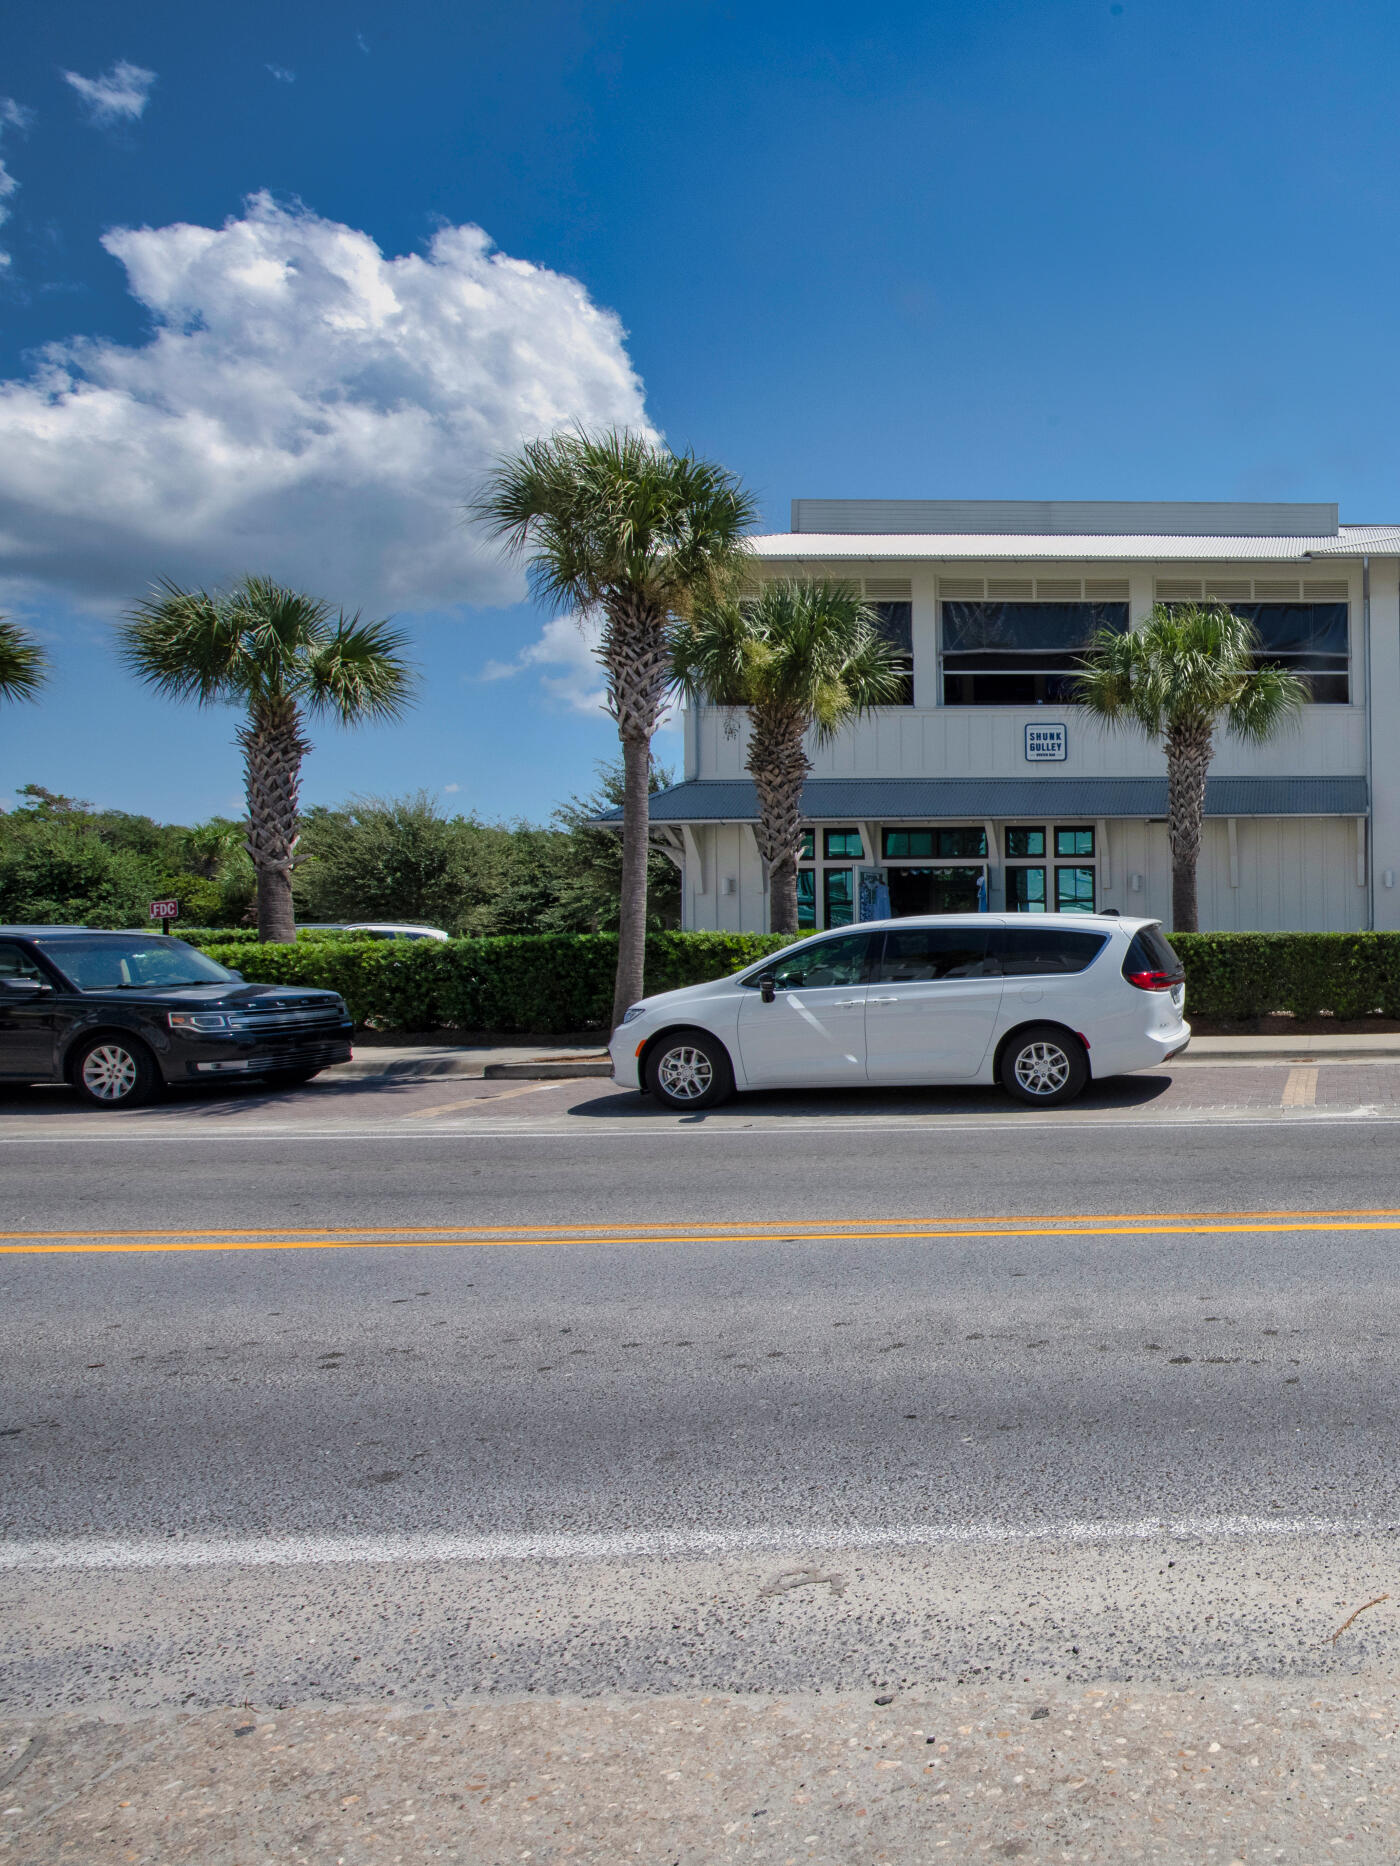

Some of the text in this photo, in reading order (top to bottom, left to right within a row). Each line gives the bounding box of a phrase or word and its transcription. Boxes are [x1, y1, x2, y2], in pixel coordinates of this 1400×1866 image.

[1030, 732, 1062, 741] SHUNK
[1030, 742, 1062, 751] GULLEY
[153, 903, 175, 916] FDC
